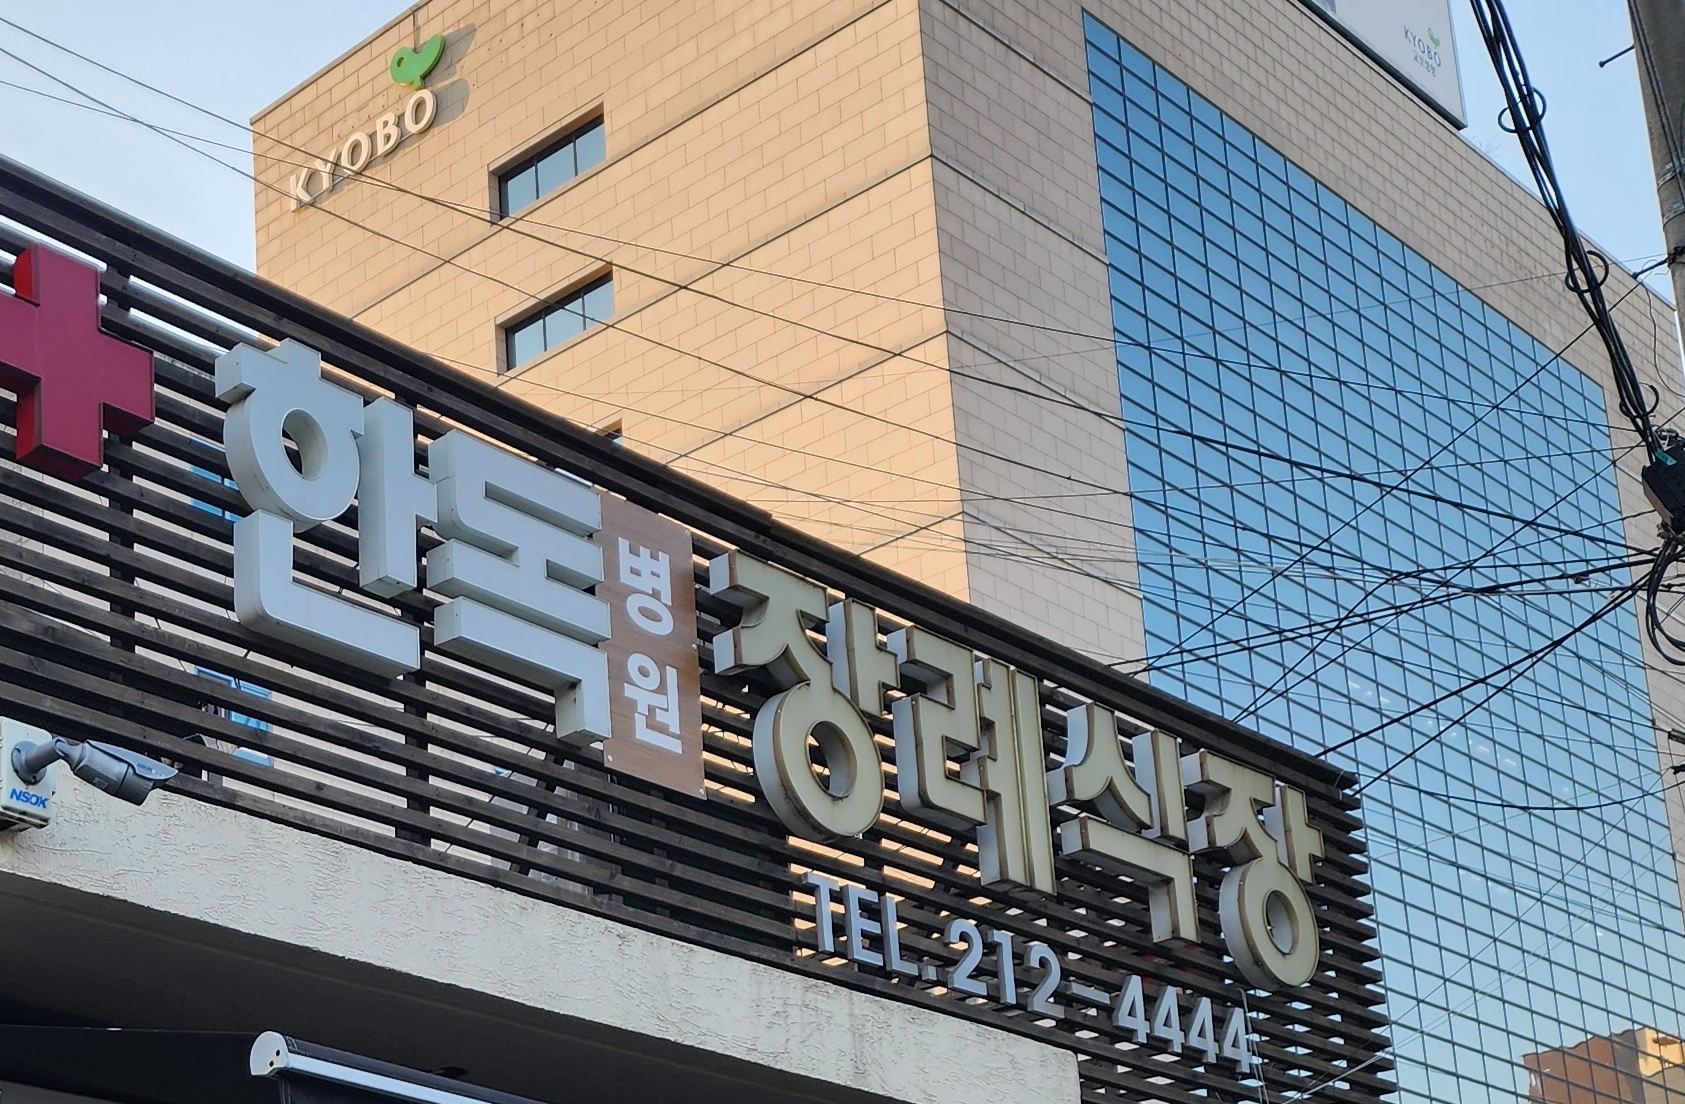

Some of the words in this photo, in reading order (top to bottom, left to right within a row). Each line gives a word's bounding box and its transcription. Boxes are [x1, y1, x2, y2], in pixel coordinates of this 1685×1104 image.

[1404, 26, 1441, 67] KYOBO
[289, 88, 437, 213] KYOBO
[215, 337, 612, 748] 한독
[617, 535, 684, 754] 병원
[710, 548, 1325, 991] 장례식장
[10, 788, 50, 809] NSOK
